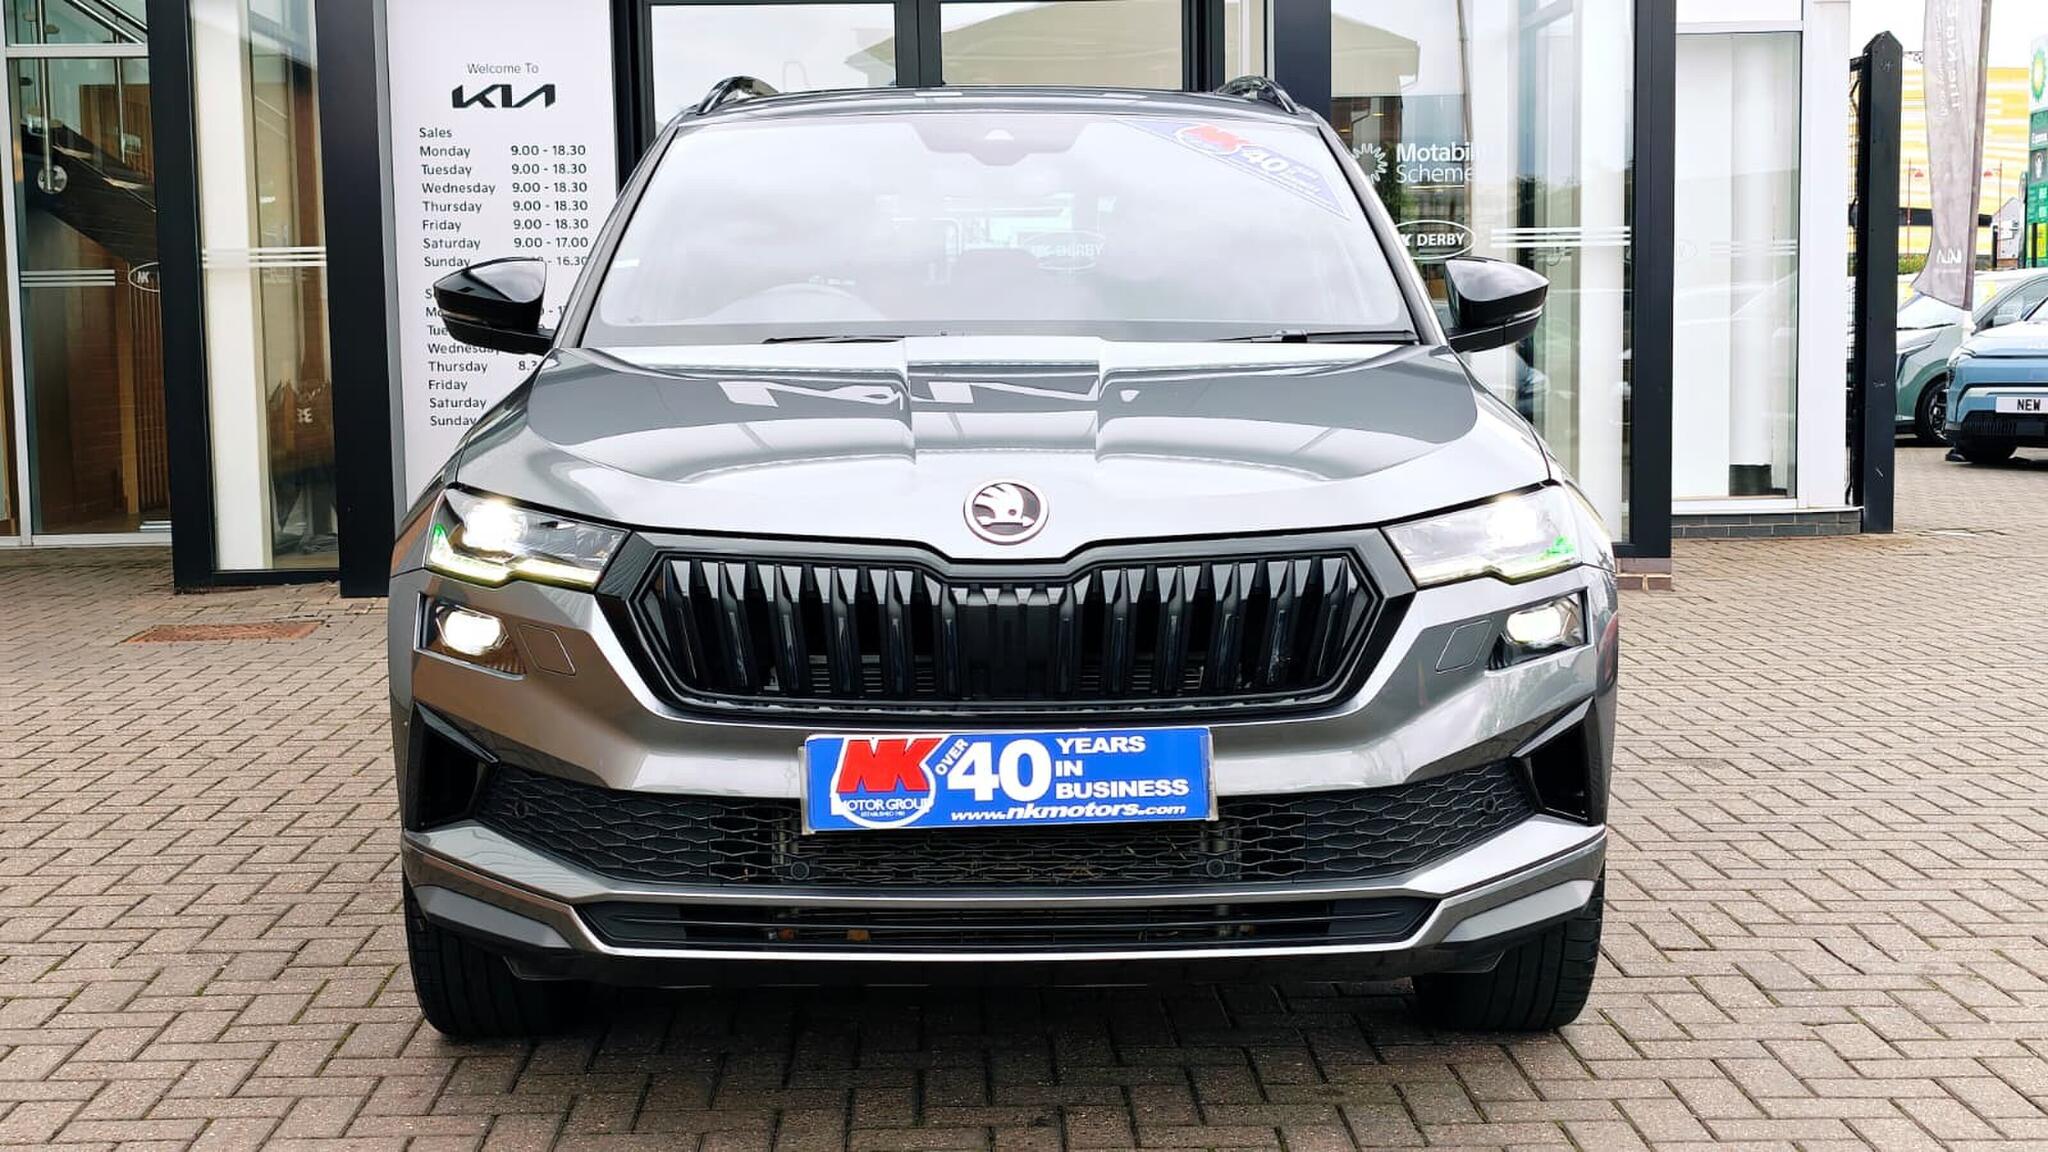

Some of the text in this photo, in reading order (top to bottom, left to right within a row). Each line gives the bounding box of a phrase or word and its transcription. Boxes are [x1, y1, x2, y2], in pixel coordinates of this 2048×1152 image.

[466, 62, 539, 74] Welcome To
[451, 83, 556, 109] KIA
[419, 127, 453, 139] Sales
[419, 146, 471, 159] Monday
[510, 144, 540, 156] 9.00
[552, 145, 587, 156] 18.30
[421, 164, 472, 177] Tuesday
[511, 163, 540, 175] 9.00
[553, 163, 588, 175] 18.30
[1396, 165, 1475, 183] Scheme
[421, 182, 496, 195] Wednesday
[512, 182, 541, 193] 9.00
[554, 181, 588, 193] 18.30
[422, 200, 482, 214] Thursday
[512, 200, 541, 211] 9.00
[554, 200, 589, 211] 18.30
[422, 219, 462, 232] Friday
[513, 219, 542, 230] 9.00
[555, 218, 589, 230] 18.30
[423, 238, 481, 251] Saturday
[513, 237, 543, 248] 9.00
[555, 236, 589, 248] 17.00
[1416, 233, 1466, 247] DERBY
[424, 256, 470, 268] Sunday
[428, 361, 488, 374] Thursday
[428, 380, 468, 392] Friday
[430, 397, 487, 410] Saturday
[2017, 399, 2041, 411] NEW
[430, 415, 477, 426] Sunday
[1055, 736, 1146, 754] YEARS
[836, 738, 943, 794] NK
[934, 738, 1052, 802] OVER 40
[1055, 760, 1083, 777] IN
[1055, 779, 1190, 800] BUSINESS
[839, 798, 929, 811] OTOR GROU
[951, 803, 1186, 821] www.nkmotors.com
